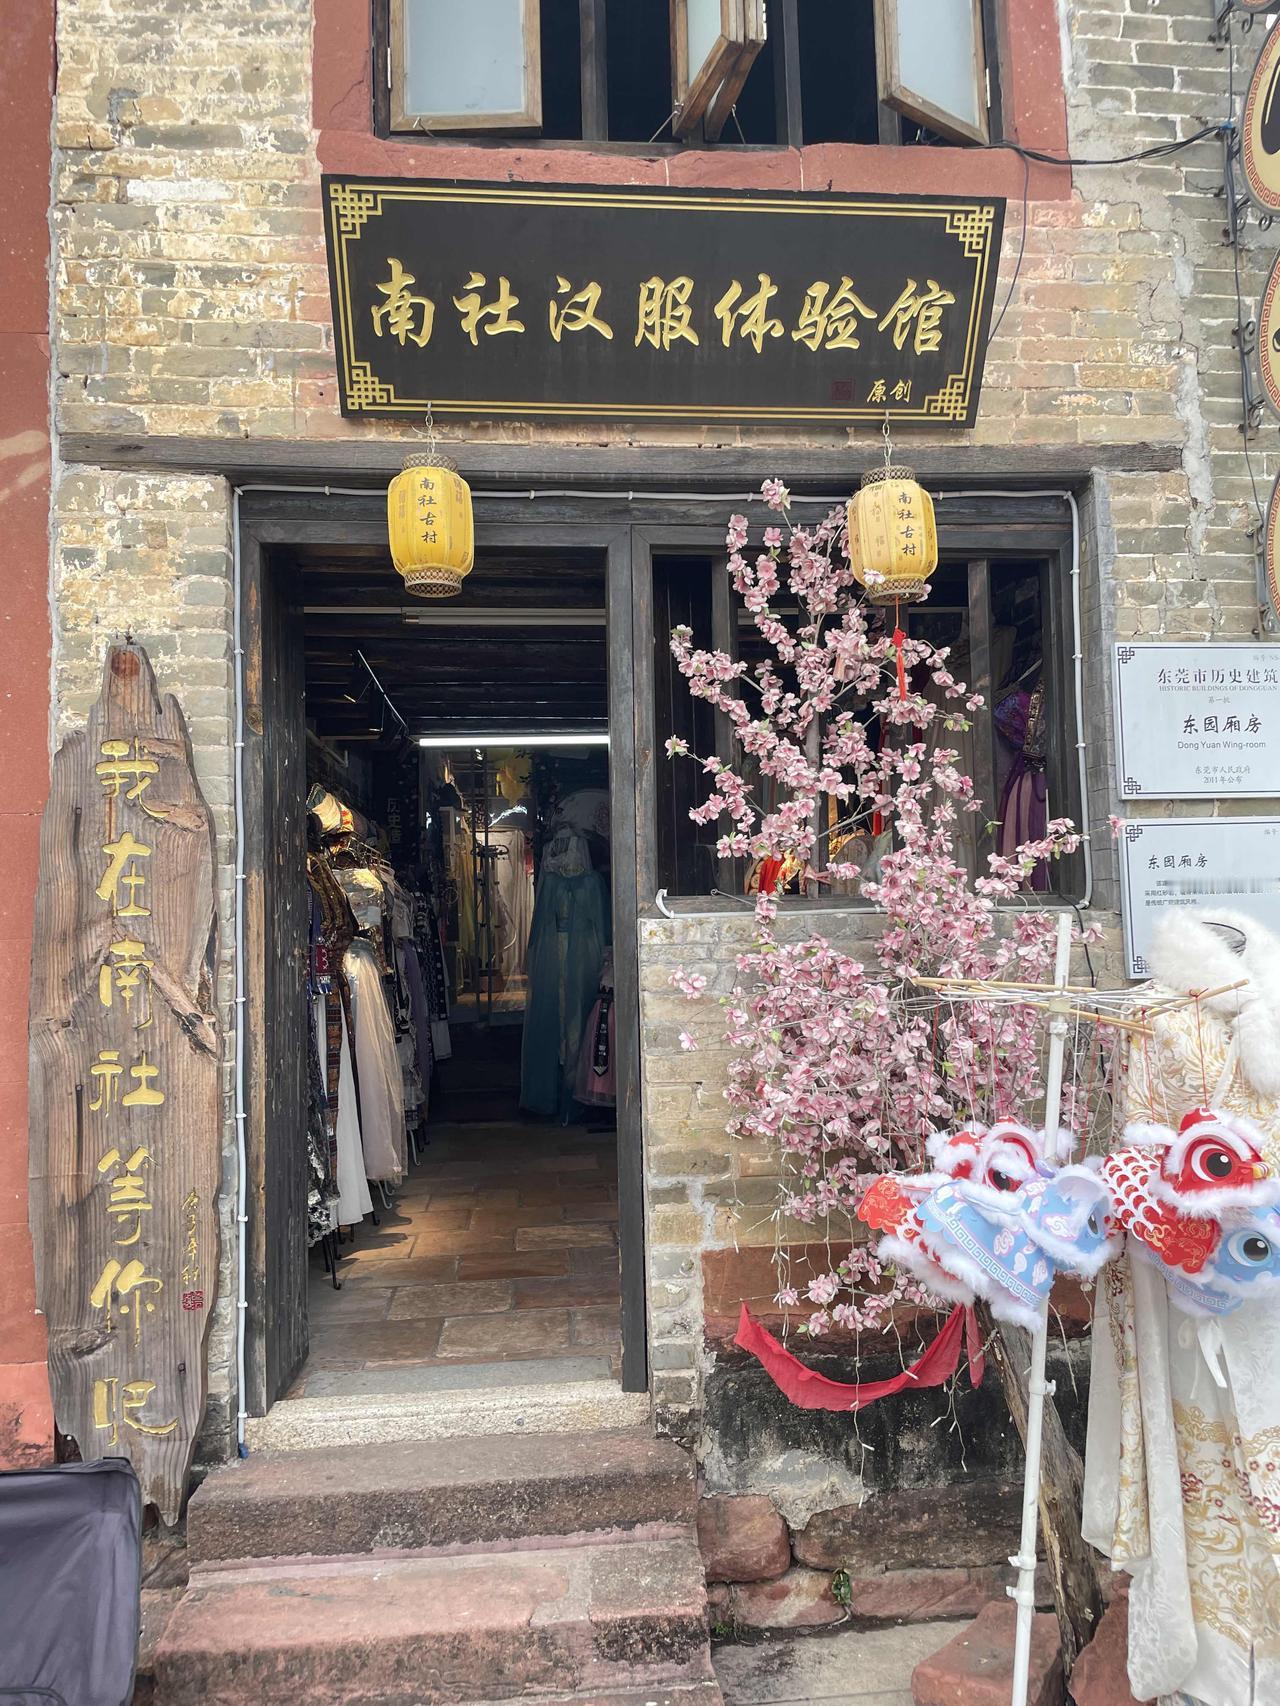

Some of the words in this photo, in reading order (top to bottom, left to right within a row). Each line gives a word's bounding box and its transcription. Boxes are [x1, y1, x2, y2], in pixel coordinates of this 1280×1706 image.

[370, 256, 956, 356] 南社汉服体验馆
[866, 378, 912, 403] 原创
[417, 477, 438, 544] 南社古村
[897, 492, 917, 556] 南社古村
[1158, 668, 1279, 684] 东莞市历史建筑
[1183, 713, 1262, 734] 东园厢房
[1177, 741, 1199, 751] Dong
[1200, 741, 1221, 749] Yuan
[1222, 740, 1266, 750] Wing-room
[1195, 765, 1251, 775] 东莞市人民政府
[1203, 776, 1243, 785] 2011年公布
[1148, 853, 1208, 870] 东园厢房
[90, 738, 178, 1447] 我在南社等你吧
